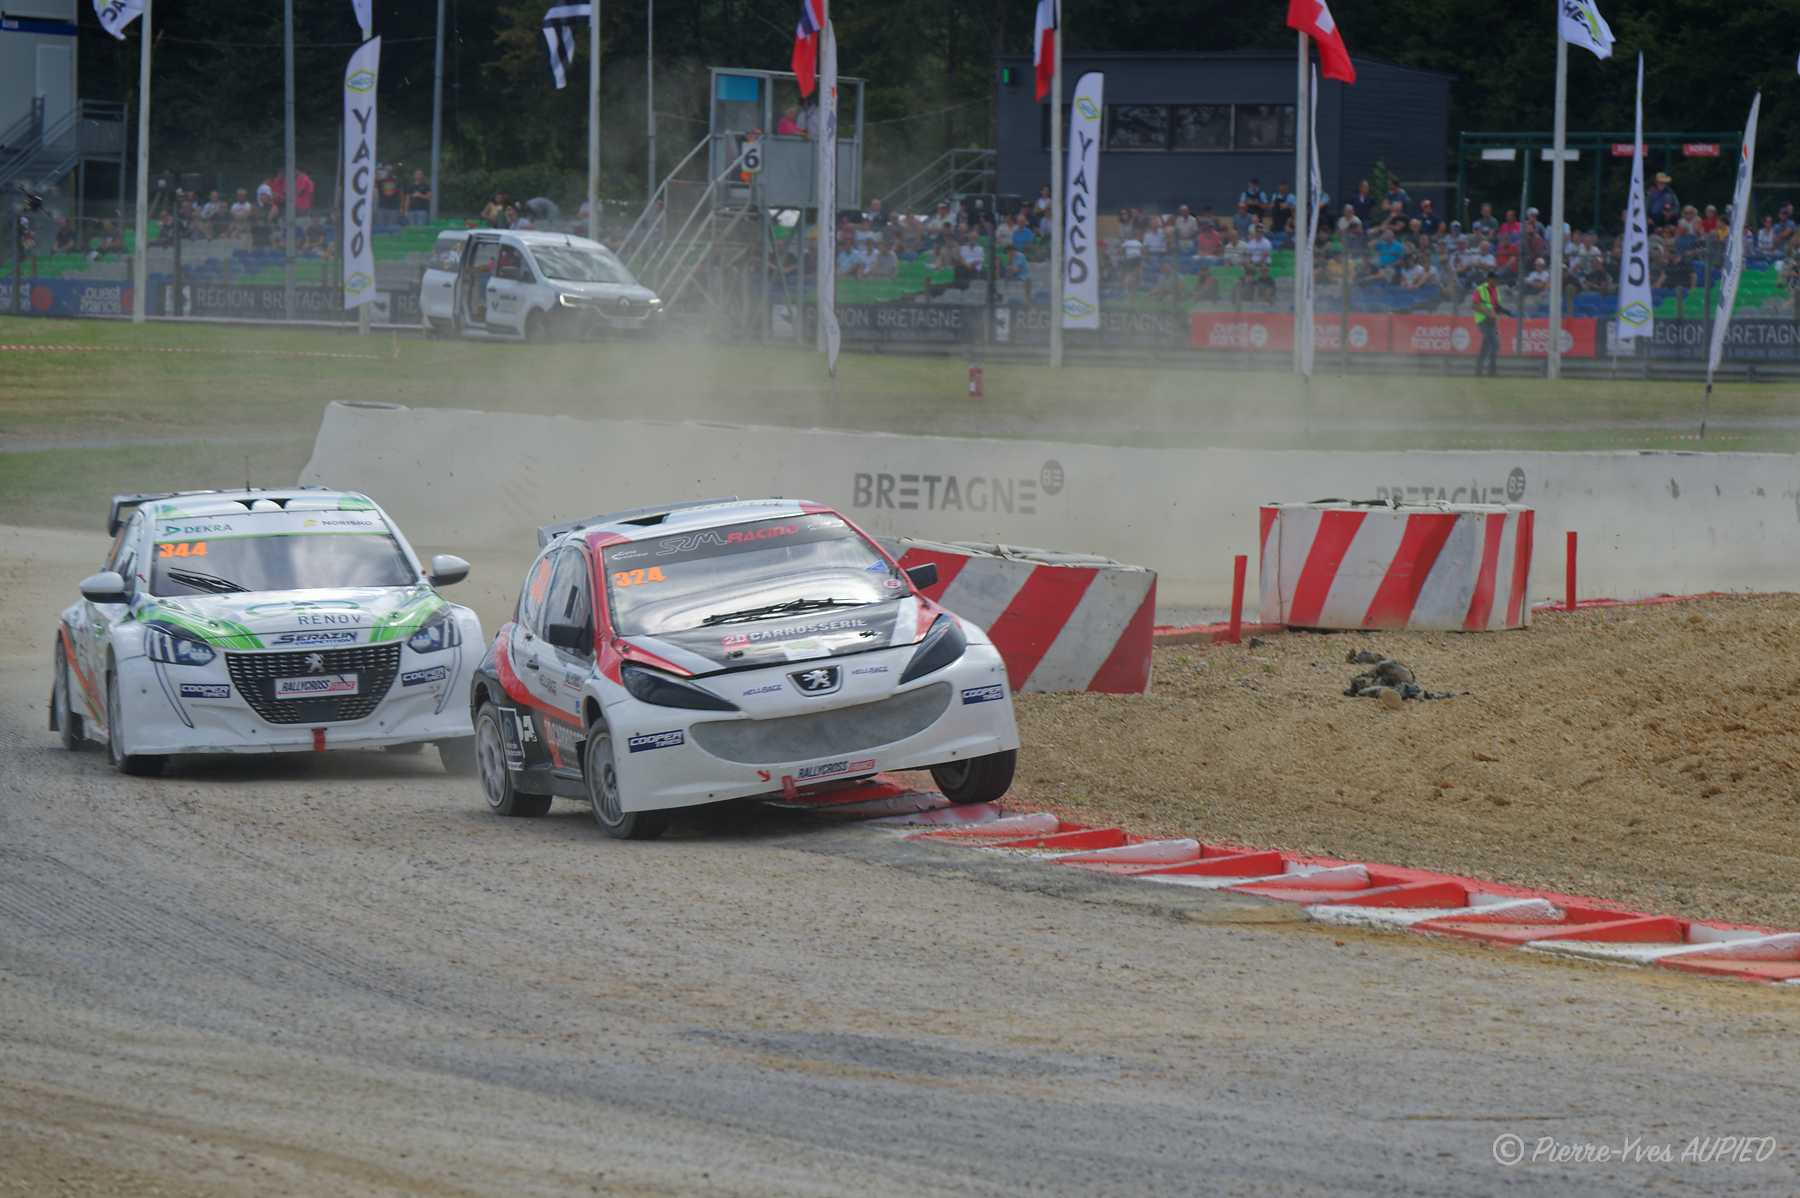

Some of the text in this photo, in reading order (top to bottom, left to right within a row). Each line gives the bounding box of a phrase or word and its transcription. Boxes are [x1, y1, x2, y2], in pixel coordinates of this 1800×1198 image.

[744, 148, 759, 168] 6
[351, 106, 373, 258] YACCO
[1067, 130, 1094, 284] YACCO
[876, 308, 961, 328] BRETAGNE
[852, 472, 1036, 515] BRETAGNE
[184, 524, 233, 534] DEKRA
[159, 541, 208, 559] 344
[613, 565, 664, 588] 324
[297, 614, 361, 625] RENOV
[271, 631, 358, 645] SERAZIN
[963, 687, 1001, 698] COOPER
[630, 732, 682, 746] COOPER
[798, 760, 849, 778] RALLYCROSS
